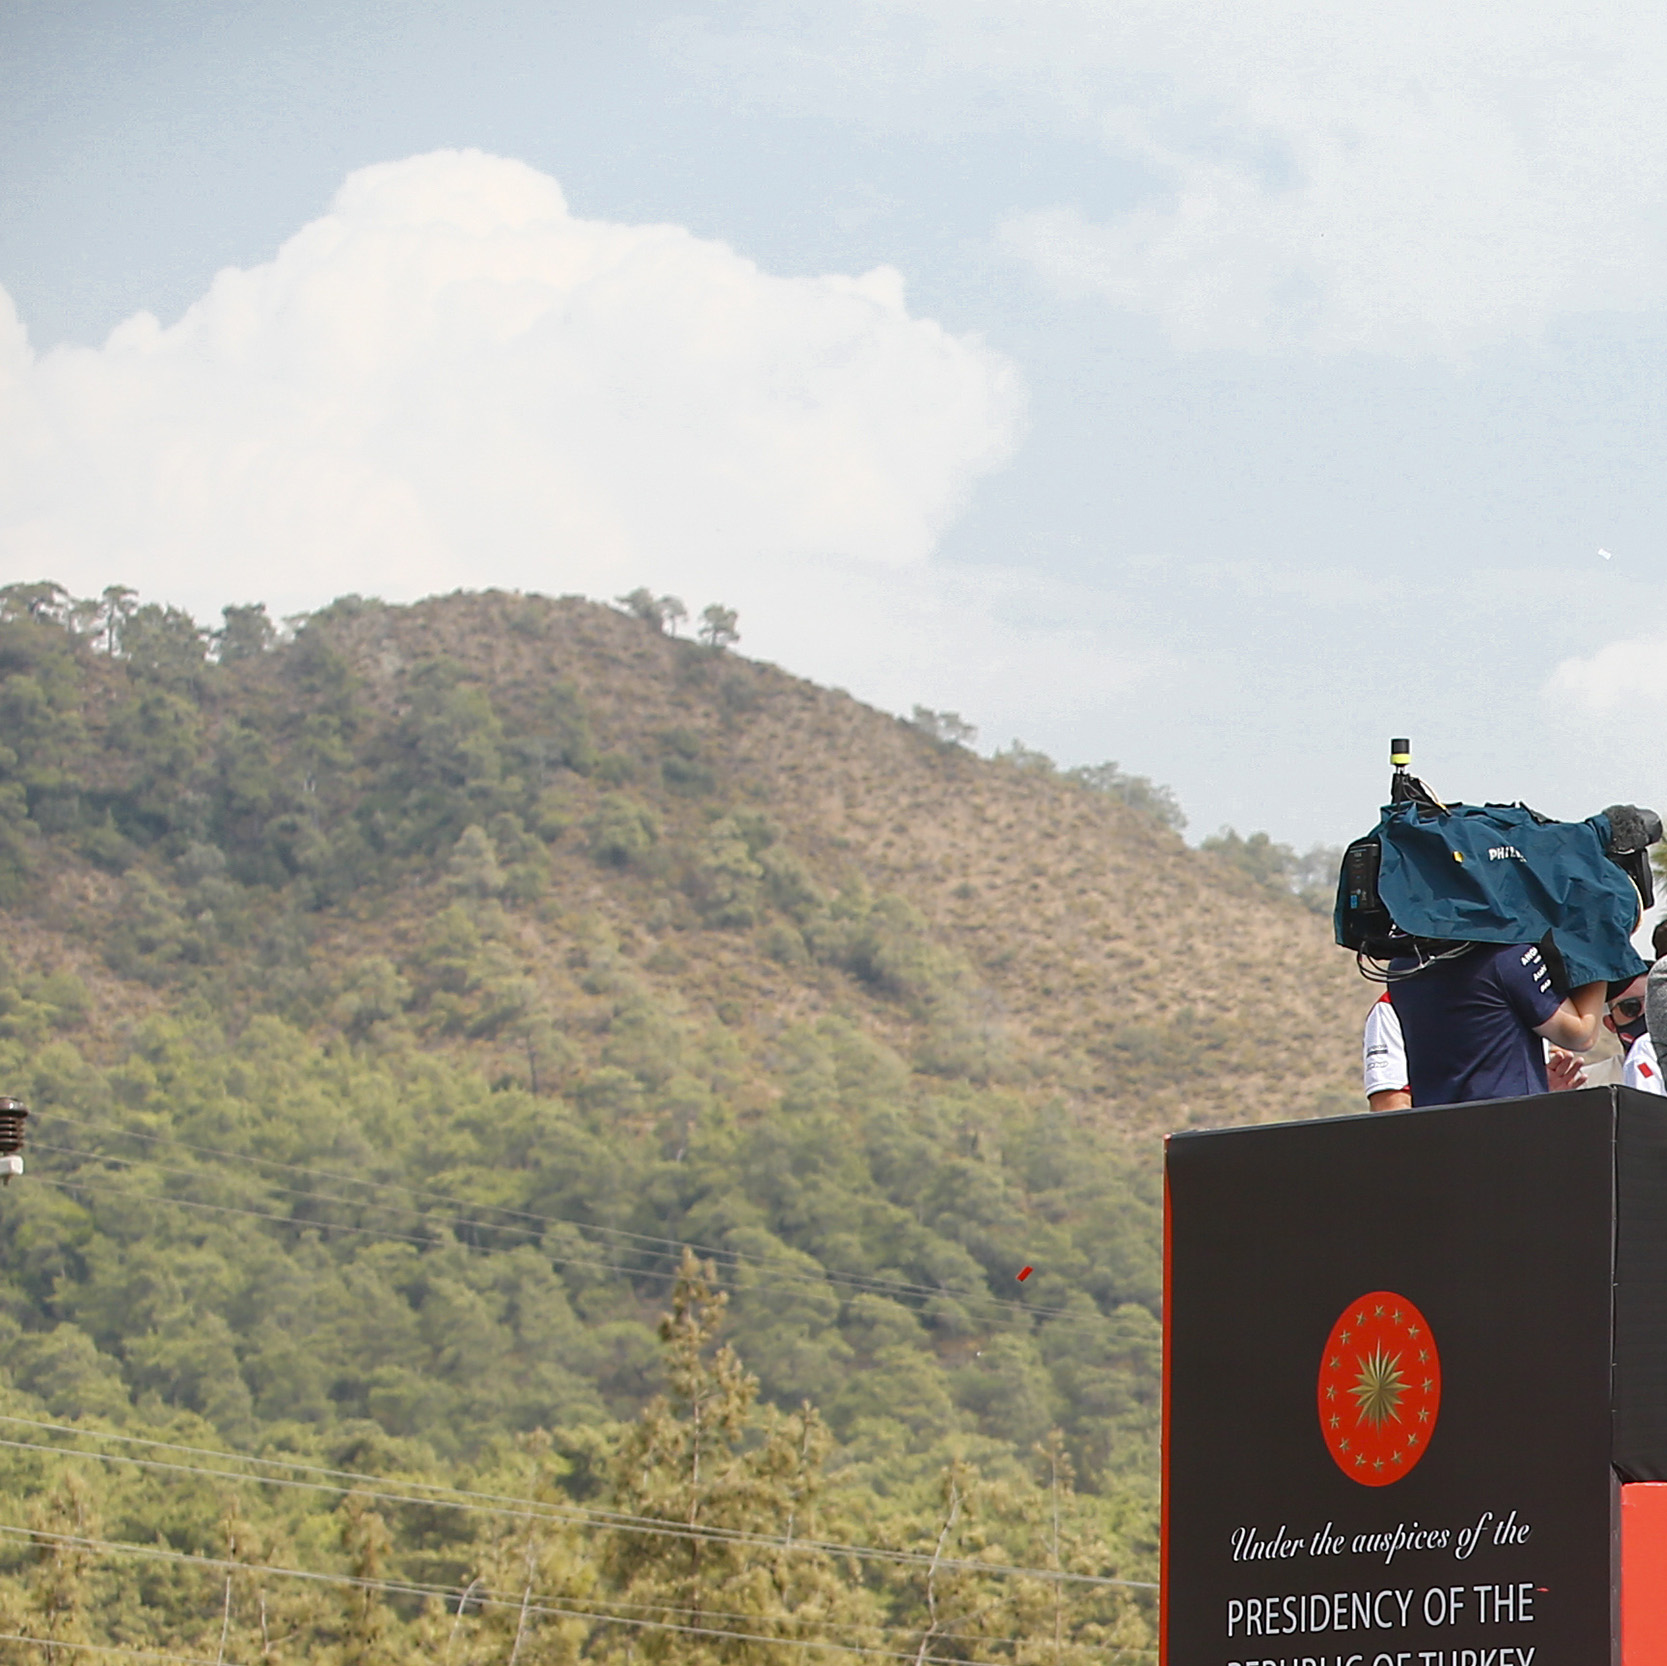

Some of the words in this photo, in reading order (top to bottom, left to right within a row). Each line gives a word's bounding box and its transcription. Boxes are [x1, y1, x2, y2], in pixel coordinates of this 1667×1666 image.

[1230, 1525, 1305, 1562] Under
[1308, 1521, 1345, 1557] the
[1352, 1521, 1451, 1565] auspices
[1454, 1512, 1493, 1560] of
[1493, 1511, 1532, 1546] the
[1227, 1588, 1414, 1638] PRESIDENCY
[1423, 1586, 1466, 1627] OF
[1473, 1582, 1535, 1623] THE
